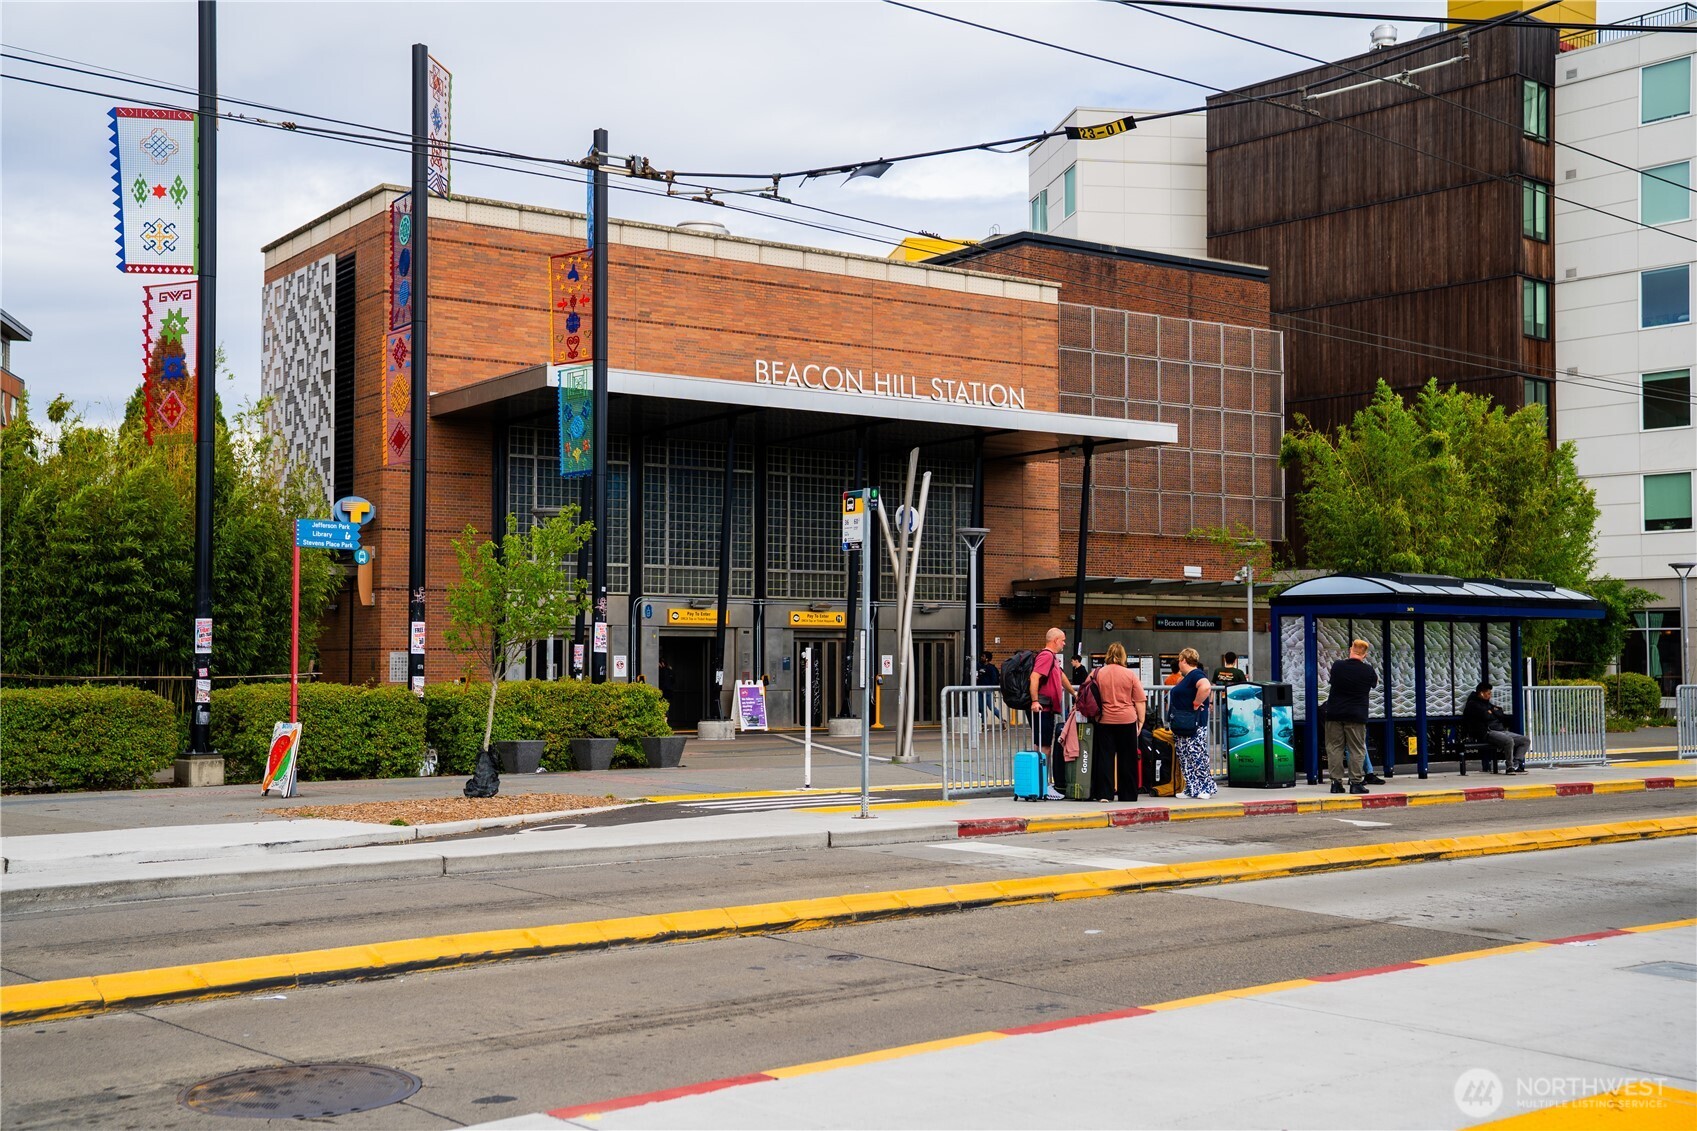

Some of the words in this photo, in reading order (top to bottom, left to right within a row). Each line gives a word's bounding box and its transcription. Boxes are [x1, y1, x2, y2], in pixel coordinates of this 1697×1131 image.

[1080, 121, 1123, 139] 23-01
[754, 359, 863, 394] BEACON
[874, 371, 922, 399] HILL
[930, 377, 1025, 409] STATION
[325, 540, 340, 548] Place
[1164, 619, 1184, 627] Beacon
[1185, 619, 1195, 627] Hill
[1196, 620, 1215, 628] Station
[1081, 750, 1089, 774] Gonex
